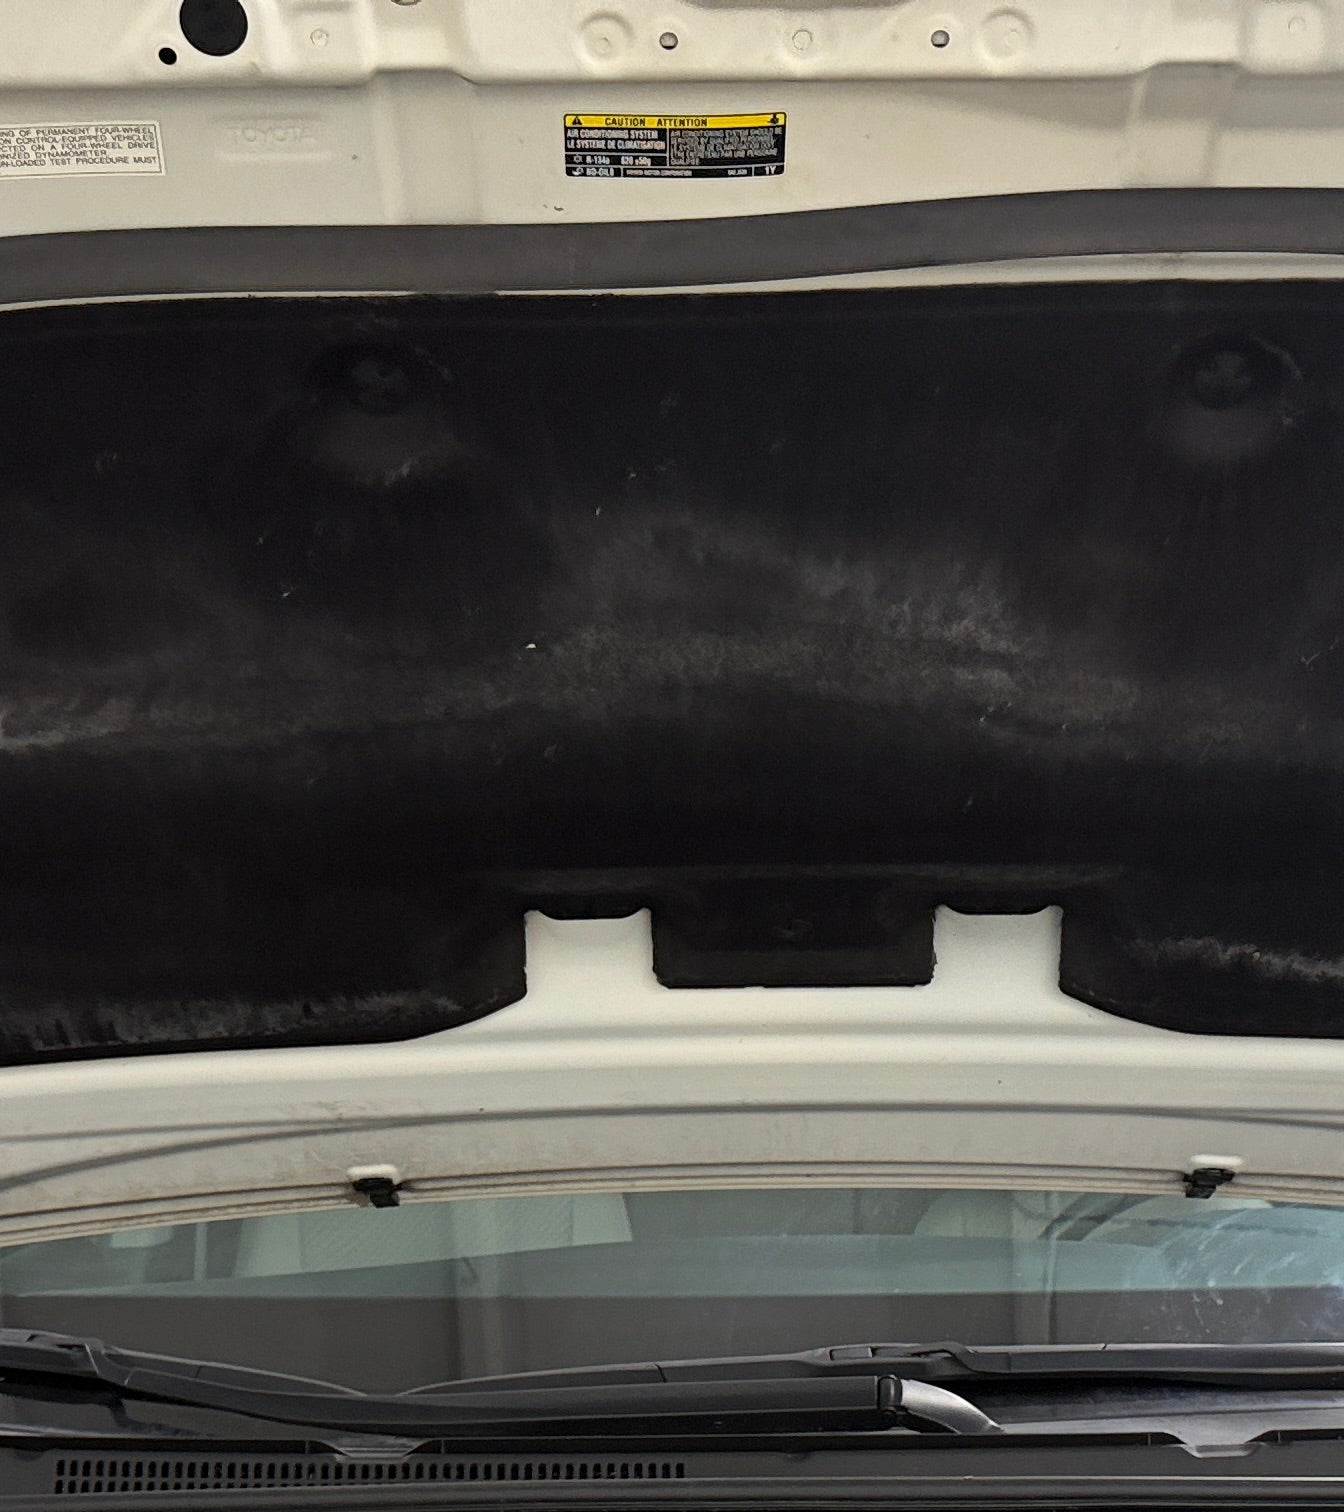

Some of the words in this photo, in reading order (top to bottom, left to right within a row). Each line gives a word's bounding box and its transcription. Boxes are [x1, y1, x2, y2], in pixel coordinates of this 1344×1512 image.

[604, 117, 646, 126] CAUTION
[656, 117, 708, 127] ATTENTION
[19, 129, 31, 137] OF
[35, 127, 90, 137] PERMANENT
[629, 130, 659, 139] SYSTEM
[111, 133, 154, 142] VEHICLES
[30, 144, 45, 152] ON
[61, 141, 123, 151] FOUR-WHEEL
[127, 141, 156, 150] DRIVE
[50, 157, 71, 166] TEST
[76, 156, 130, 165] PROCEDURE
[133, 155, 156, 164] MUST
